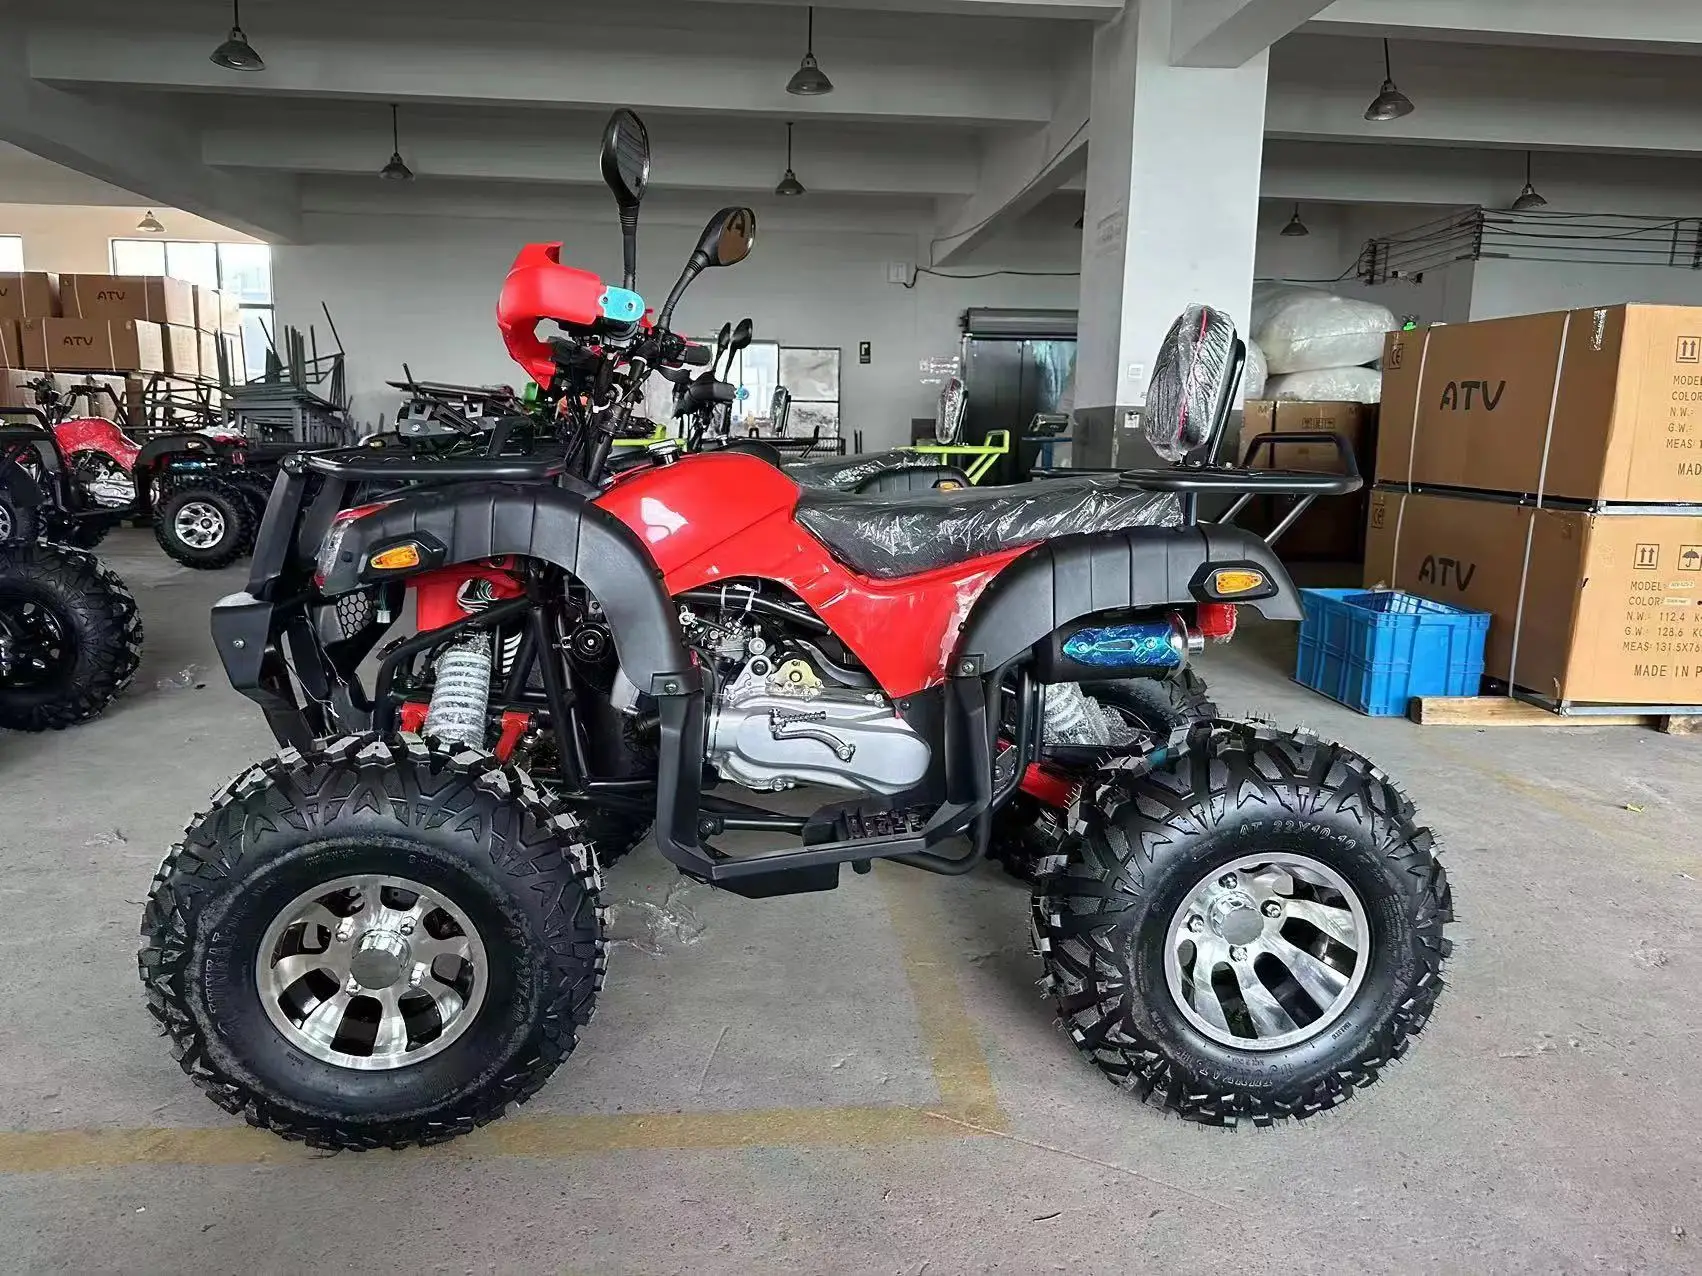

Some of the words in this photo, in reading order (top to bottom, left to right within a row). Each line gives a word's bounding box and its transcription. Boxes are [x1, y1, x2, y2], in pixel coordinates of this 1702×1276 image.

[97, 291, 126, 301] ATV
[63, 336, 93, 346] ATV
[1440, 379, 1506, 411] ATV
[1418, 555, 1476, 592] ATV
[1659, 611, 1685, 622] 112.4
[1657, 627, 1684, 637] 128.6
[1634, 664, 1668, 677] MADE
[1674, 665, 1689, 677] IN
